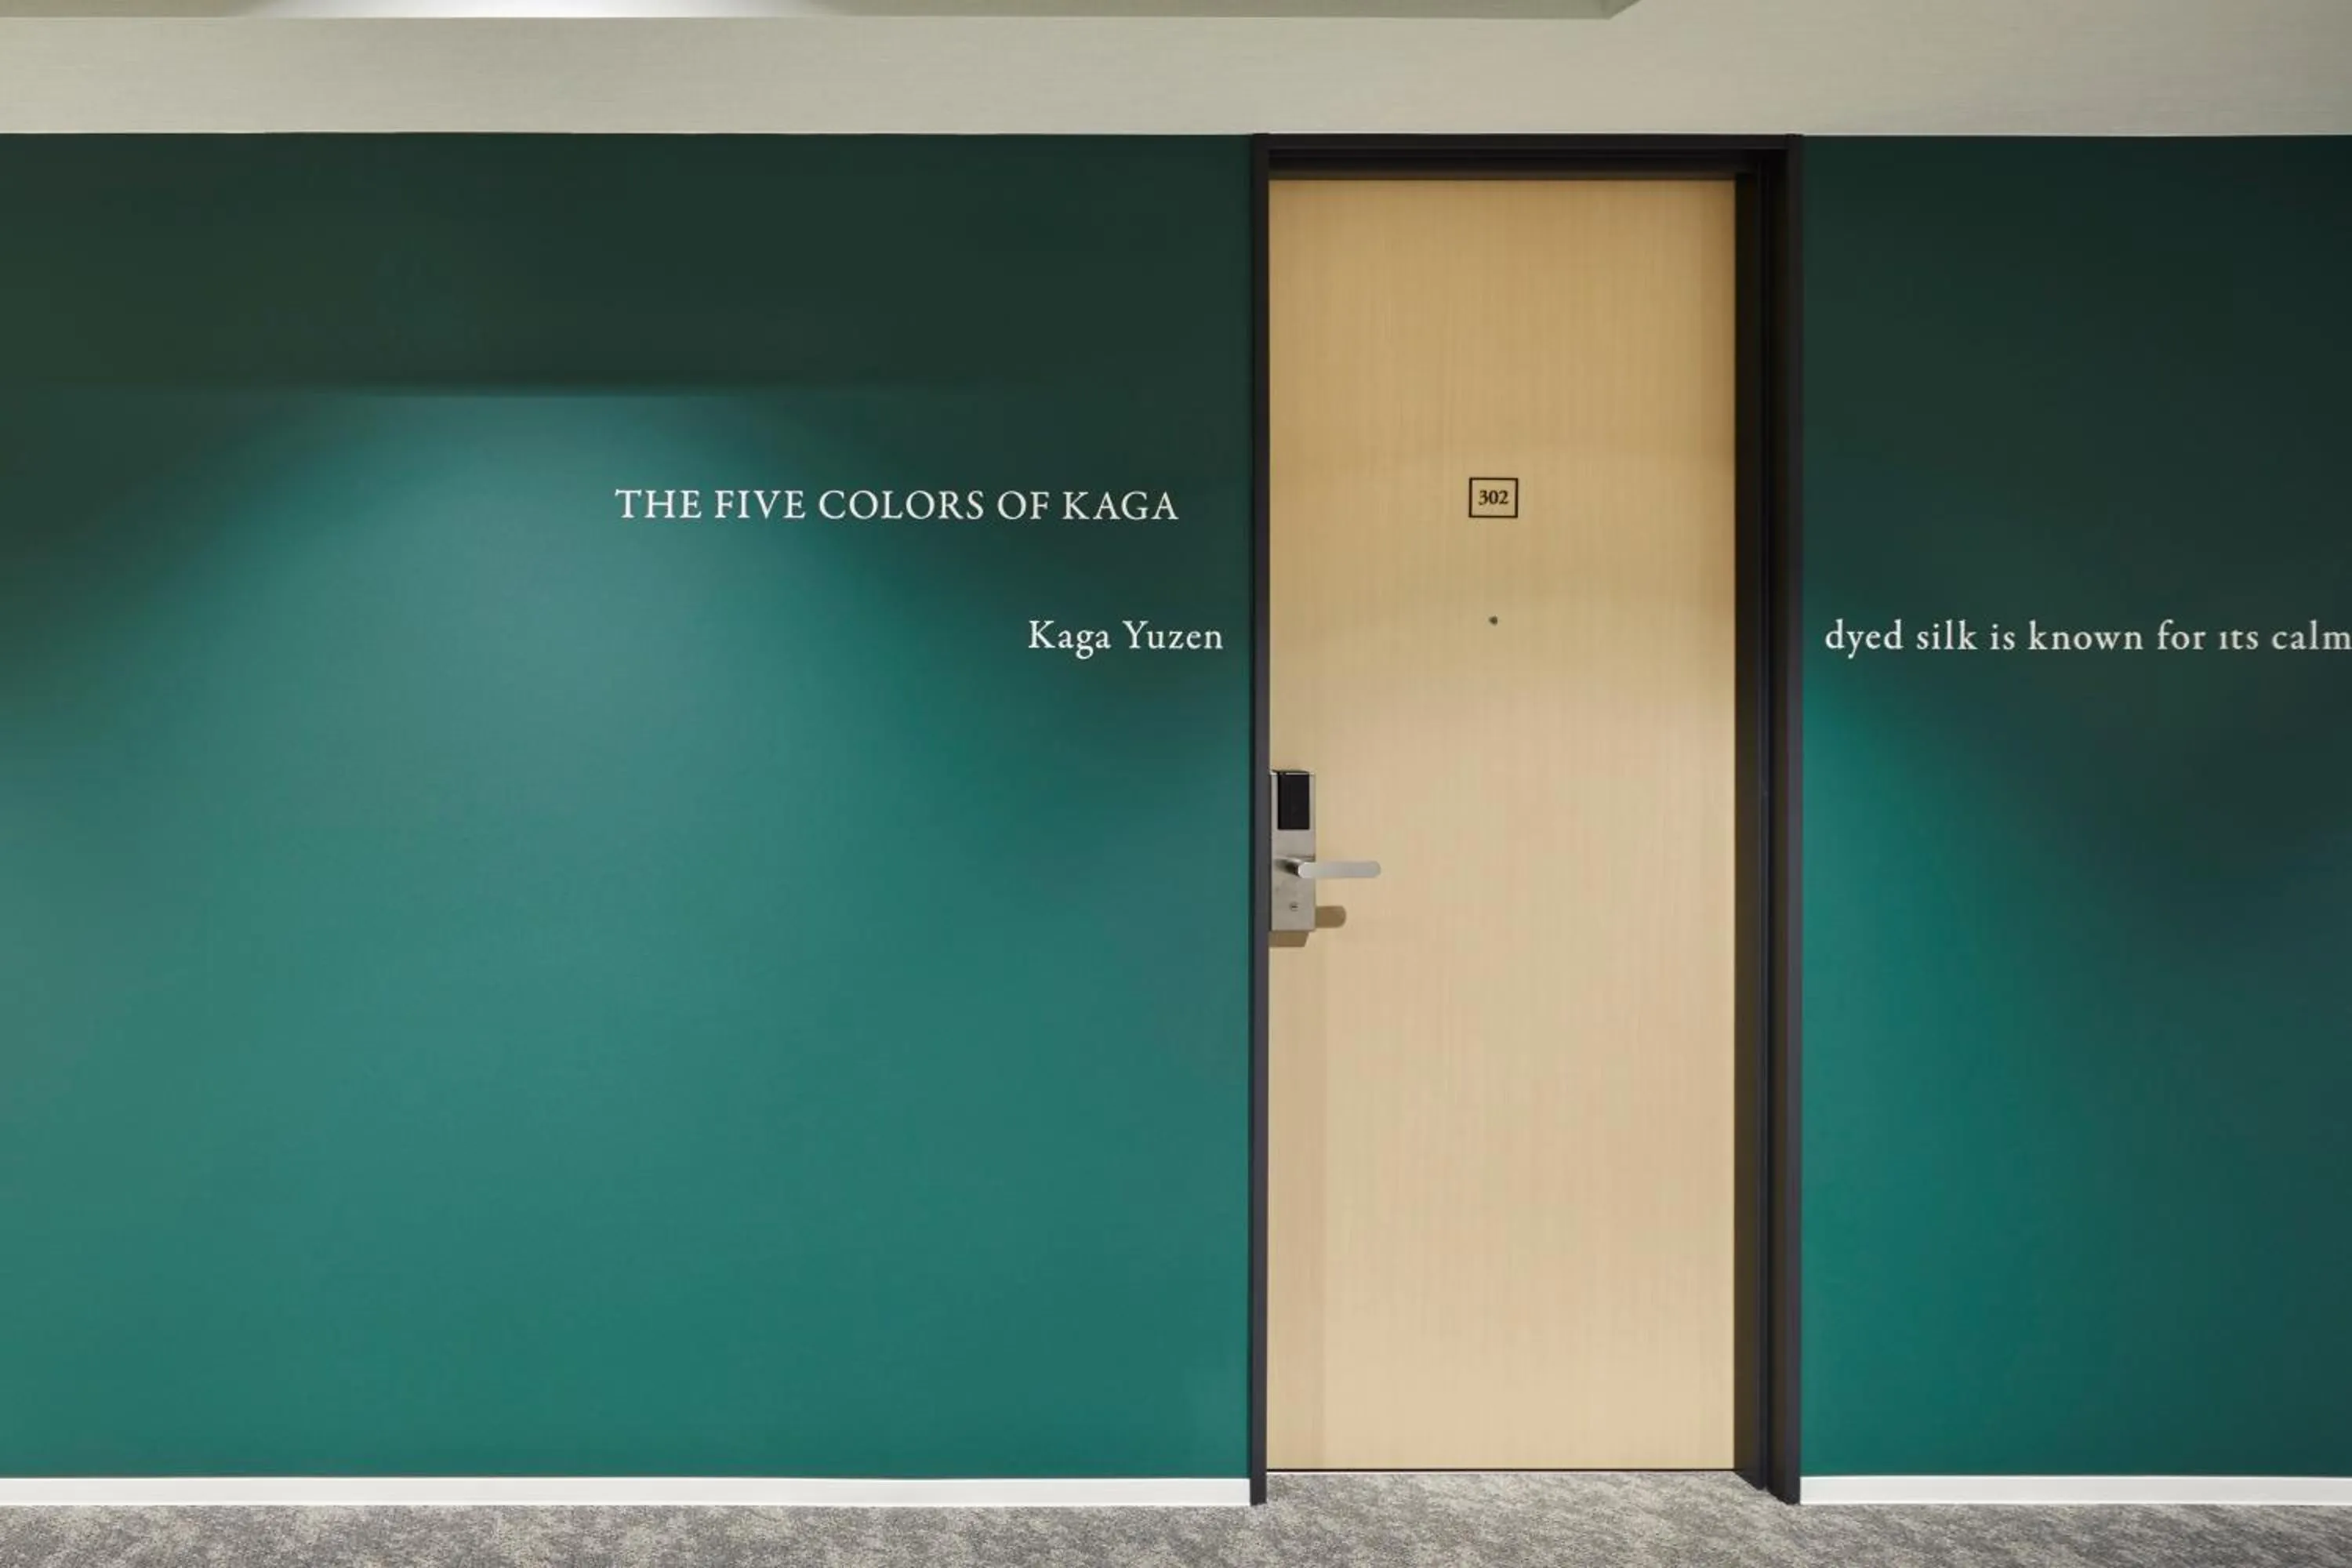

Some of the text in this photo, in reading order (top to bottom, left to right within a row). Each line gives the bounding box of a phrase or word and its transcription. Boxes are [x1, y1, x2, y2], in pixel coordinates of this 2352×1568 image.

[614, 488, 1178, 520] THE FIVE COLORS OF KAGA
[1478, 489, 1509, 506] 302
[1028, 620, 1223, 660] Kaga Yuzen
[1825, 619, 1904, 659] dyed
[1916, 619, 1978, 650] silk
[1990, 623, 2015, 650] is
[2028, 619, 2143, 650] known
[2157, 619, 2206, 650] for
[2272, 619, 2352, 650] calm
